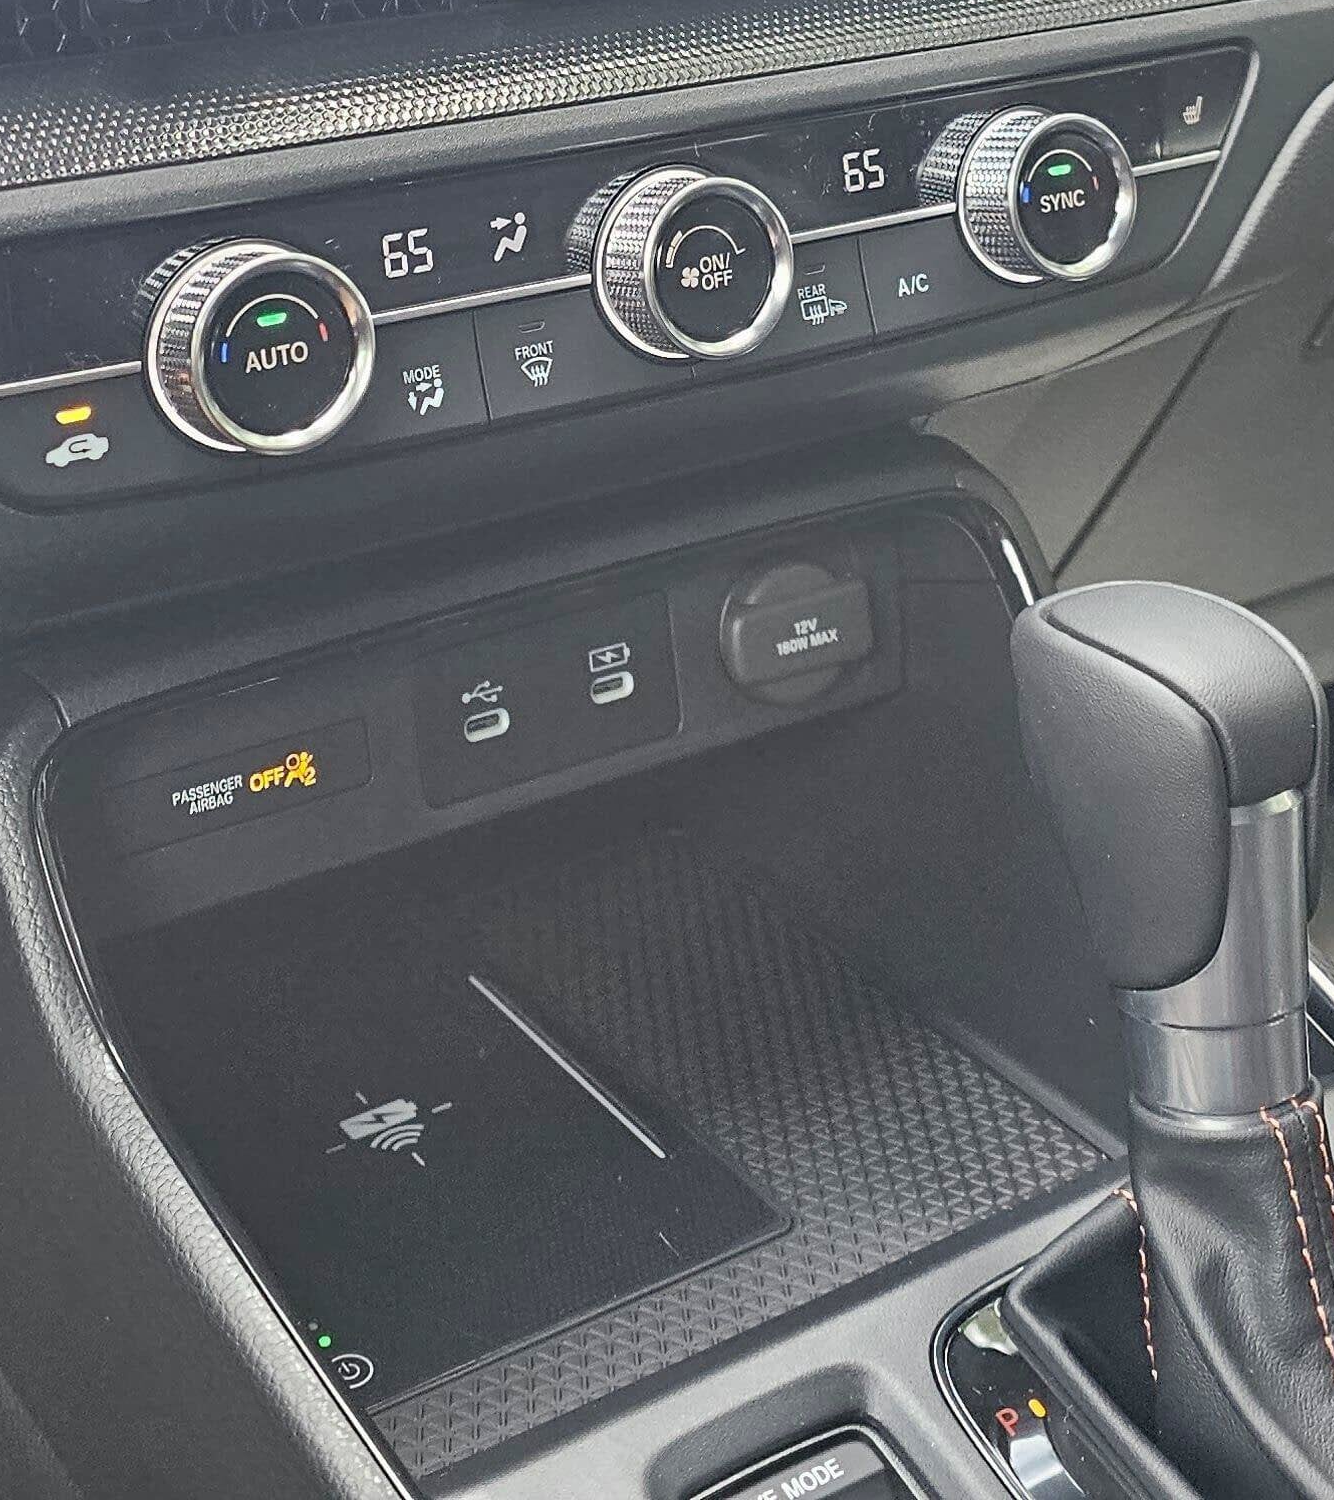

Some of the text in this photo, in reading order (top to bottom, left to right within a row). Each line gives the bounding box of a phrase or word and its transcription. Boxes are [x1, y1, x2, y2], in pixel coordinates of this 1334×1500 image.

[842, 148, 885, 194] 65
[1040, 188, 1087, 215] SYNC
[382, 227, 434, 279] 65
[699, 252, 730, 275] ON/
[701, 269, 733, 291] OFF
[797, 283, 826, 300] REAR
[898, 272, 929, 298] A/C
[244, 340, 309, 375] AUTO
[514, 340, 555, 361] FRONT
[403, 364, 442, 385] MODE
[794, 617, 817, 636] 12V
[809, 628, 838, 647] MAX
[172, 765, 285, 807] PASSENGER OFF
[189, 791, 234, 815] AIRBAG
[995, 1407, 1018, 1437] P
[780, 1457, 845, 1500] MODE
